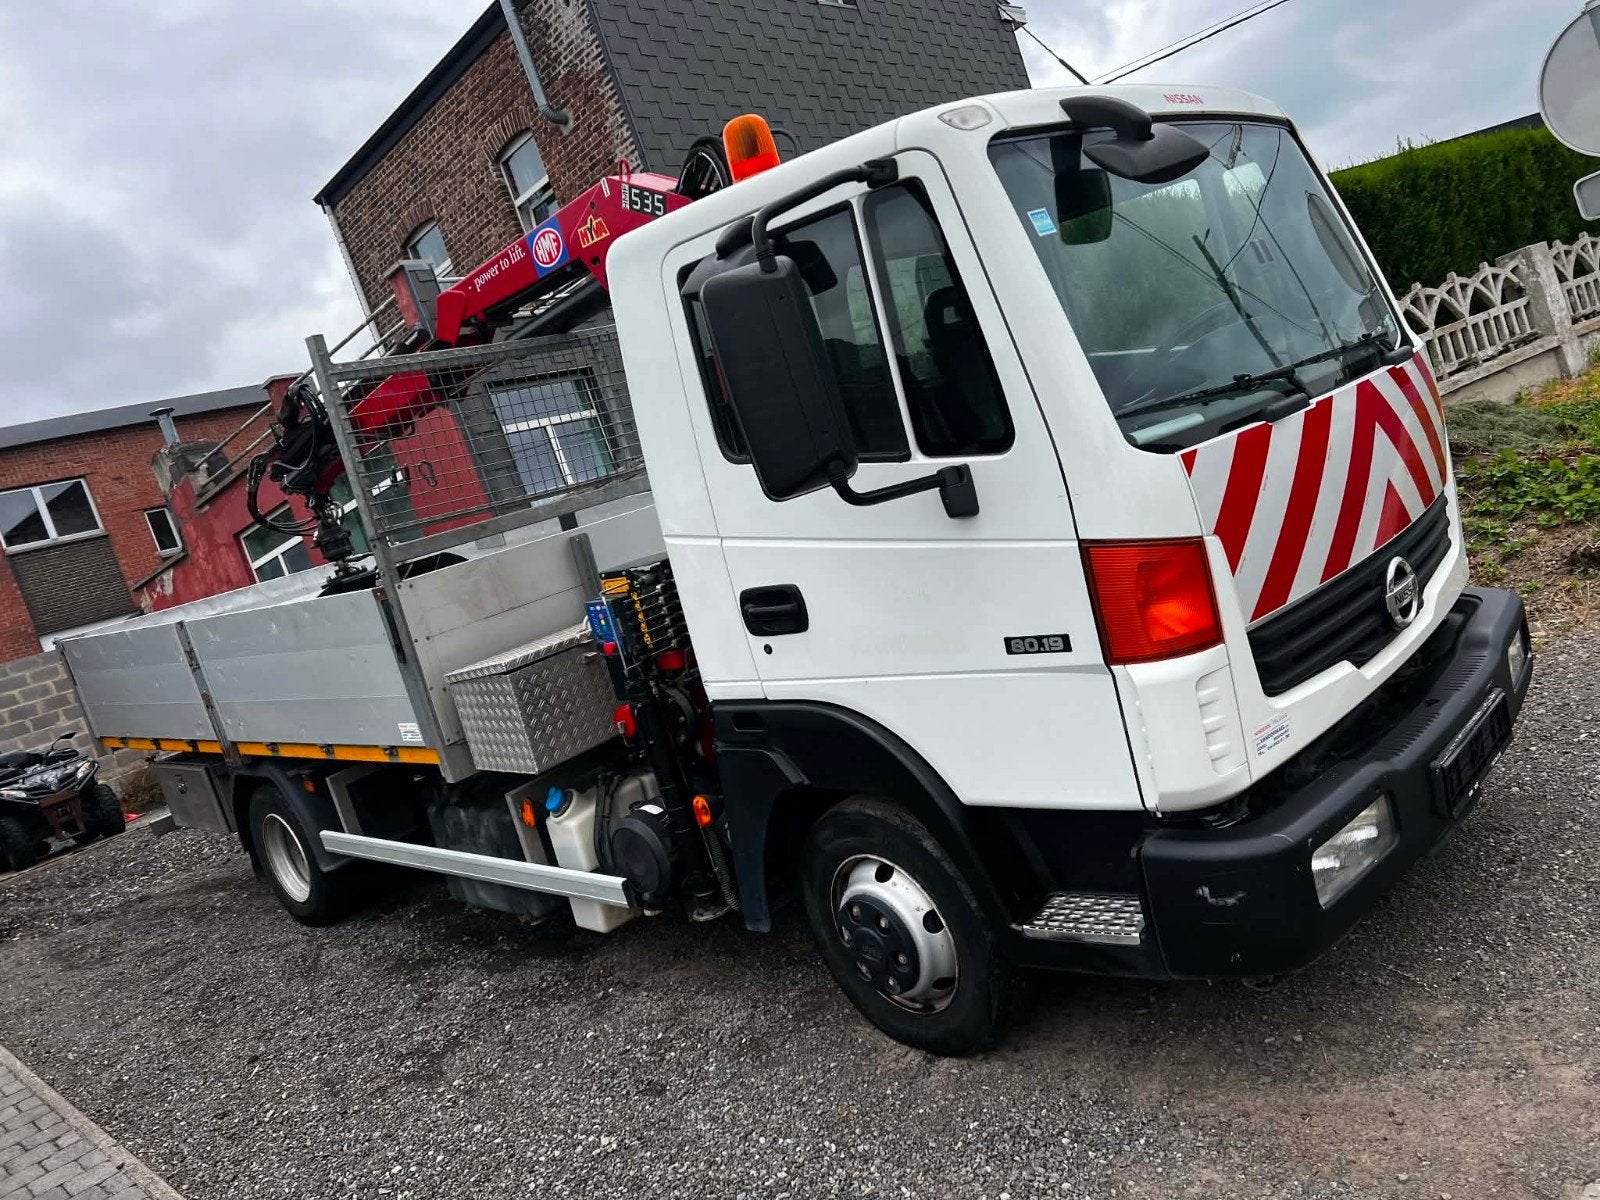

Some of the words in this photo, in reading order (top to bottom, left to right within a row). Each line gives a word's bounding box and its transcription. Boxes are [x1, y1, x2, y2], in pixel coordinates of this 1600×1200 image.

[1163, 94, 1204, 104] NISSAN
[631, 187, 664, 216] 535
[535, 232, 558, 263] HMF
[474, 264, 499, 292] power
[500, 255, 510, 271] to
[1011, 636, 1064, 653] 80.19
